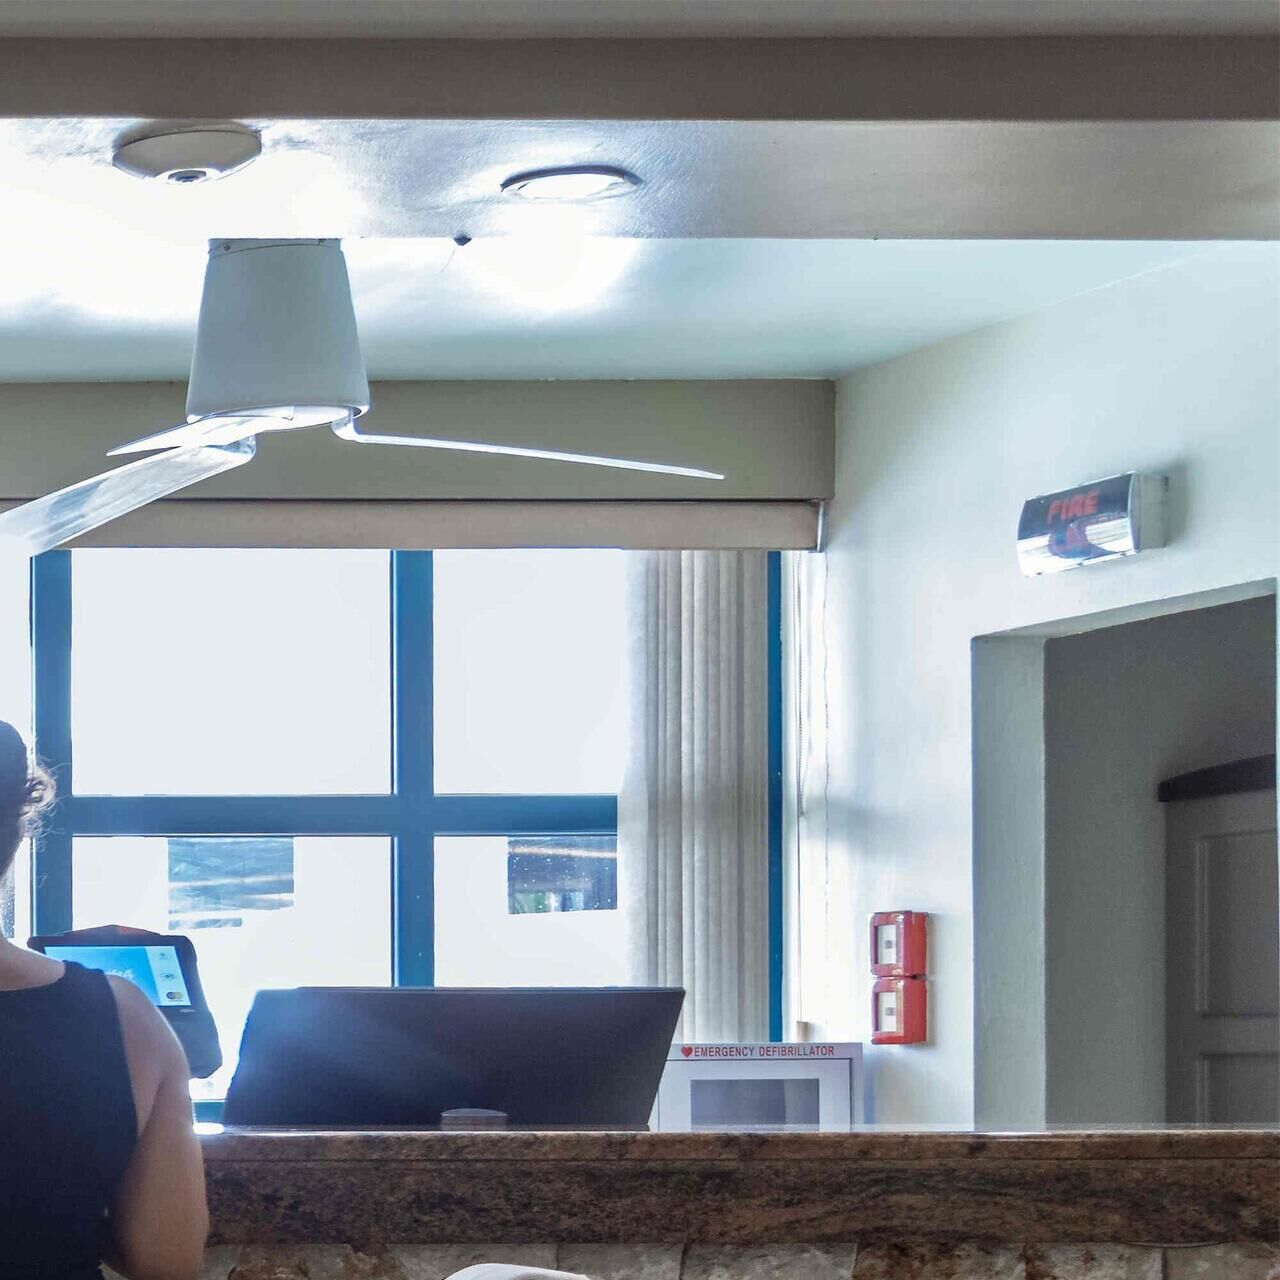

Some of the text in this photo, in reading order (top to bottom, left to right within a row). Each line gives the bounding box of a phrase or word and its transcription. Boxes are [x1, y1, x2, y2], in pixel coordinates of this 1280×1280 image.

[1048, 491, 1099, 521] FIRE
[695, 1046, 835, 1057] EMERGENCY DEFIBRILLATOR
